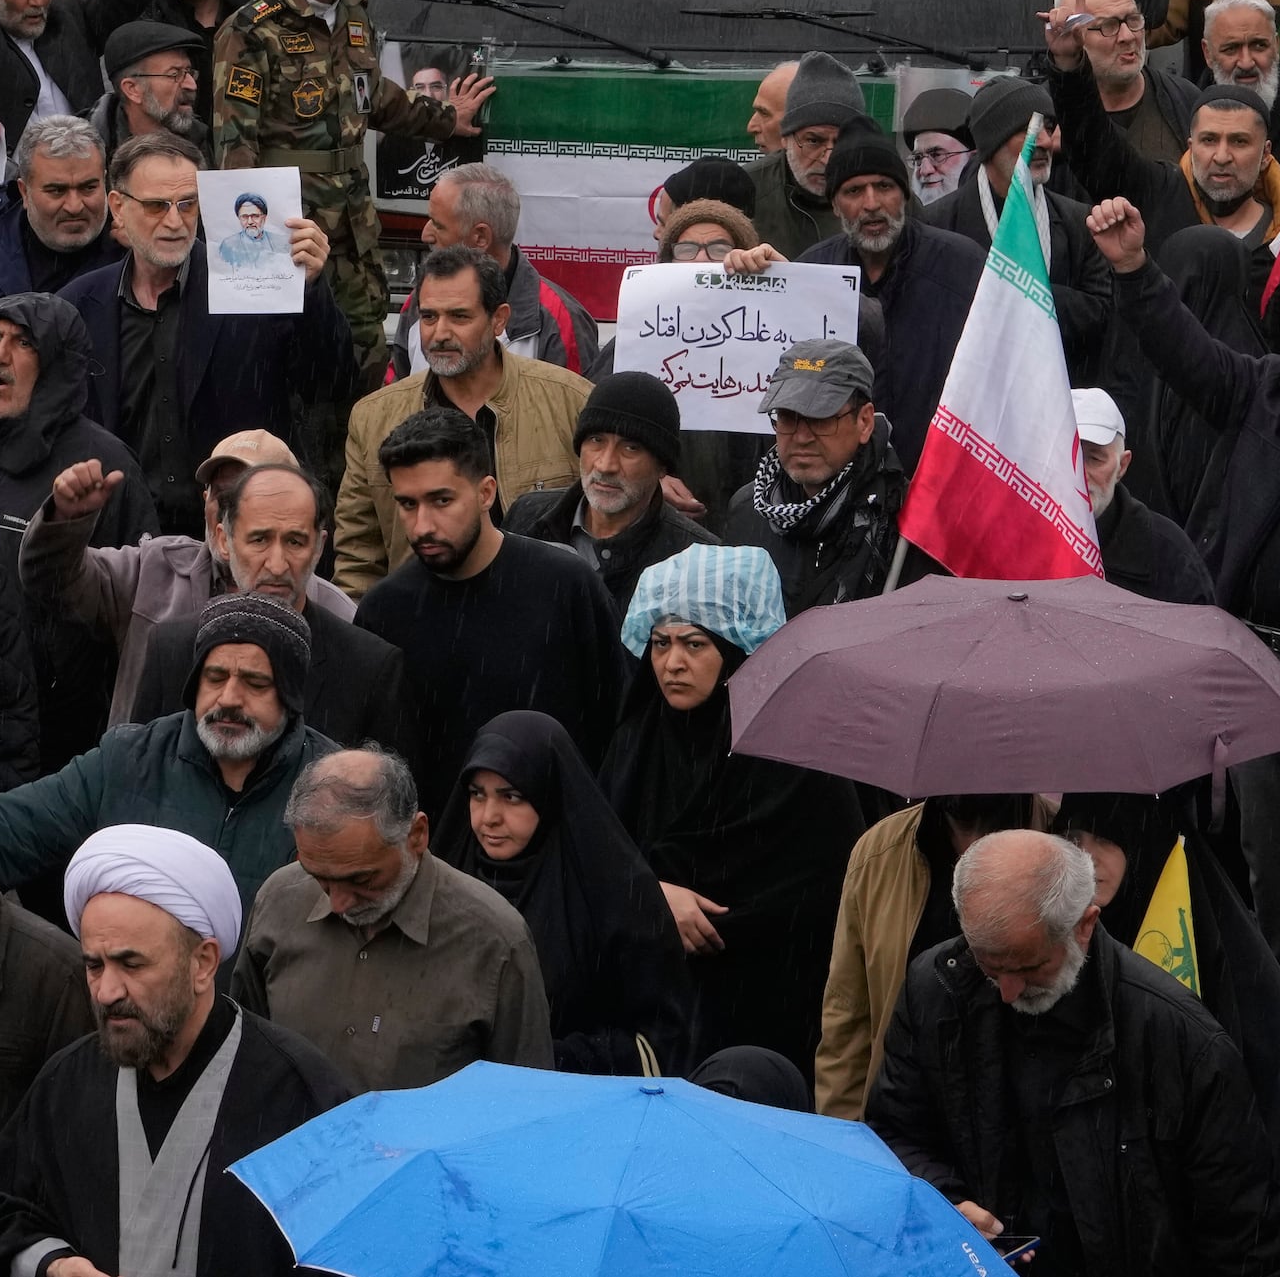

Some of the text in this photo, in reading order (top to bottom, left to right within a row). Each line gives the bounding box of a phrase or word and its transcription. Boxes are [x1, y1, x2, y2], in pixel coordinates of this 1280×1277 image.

[639, 304, 681, 338] افتاد
[681, 306, 747, 349] کردن
[734, 310, 772, 341] غلط
[773, 329, 788, 351] به
[692, 356, 744, 398] رهایت
